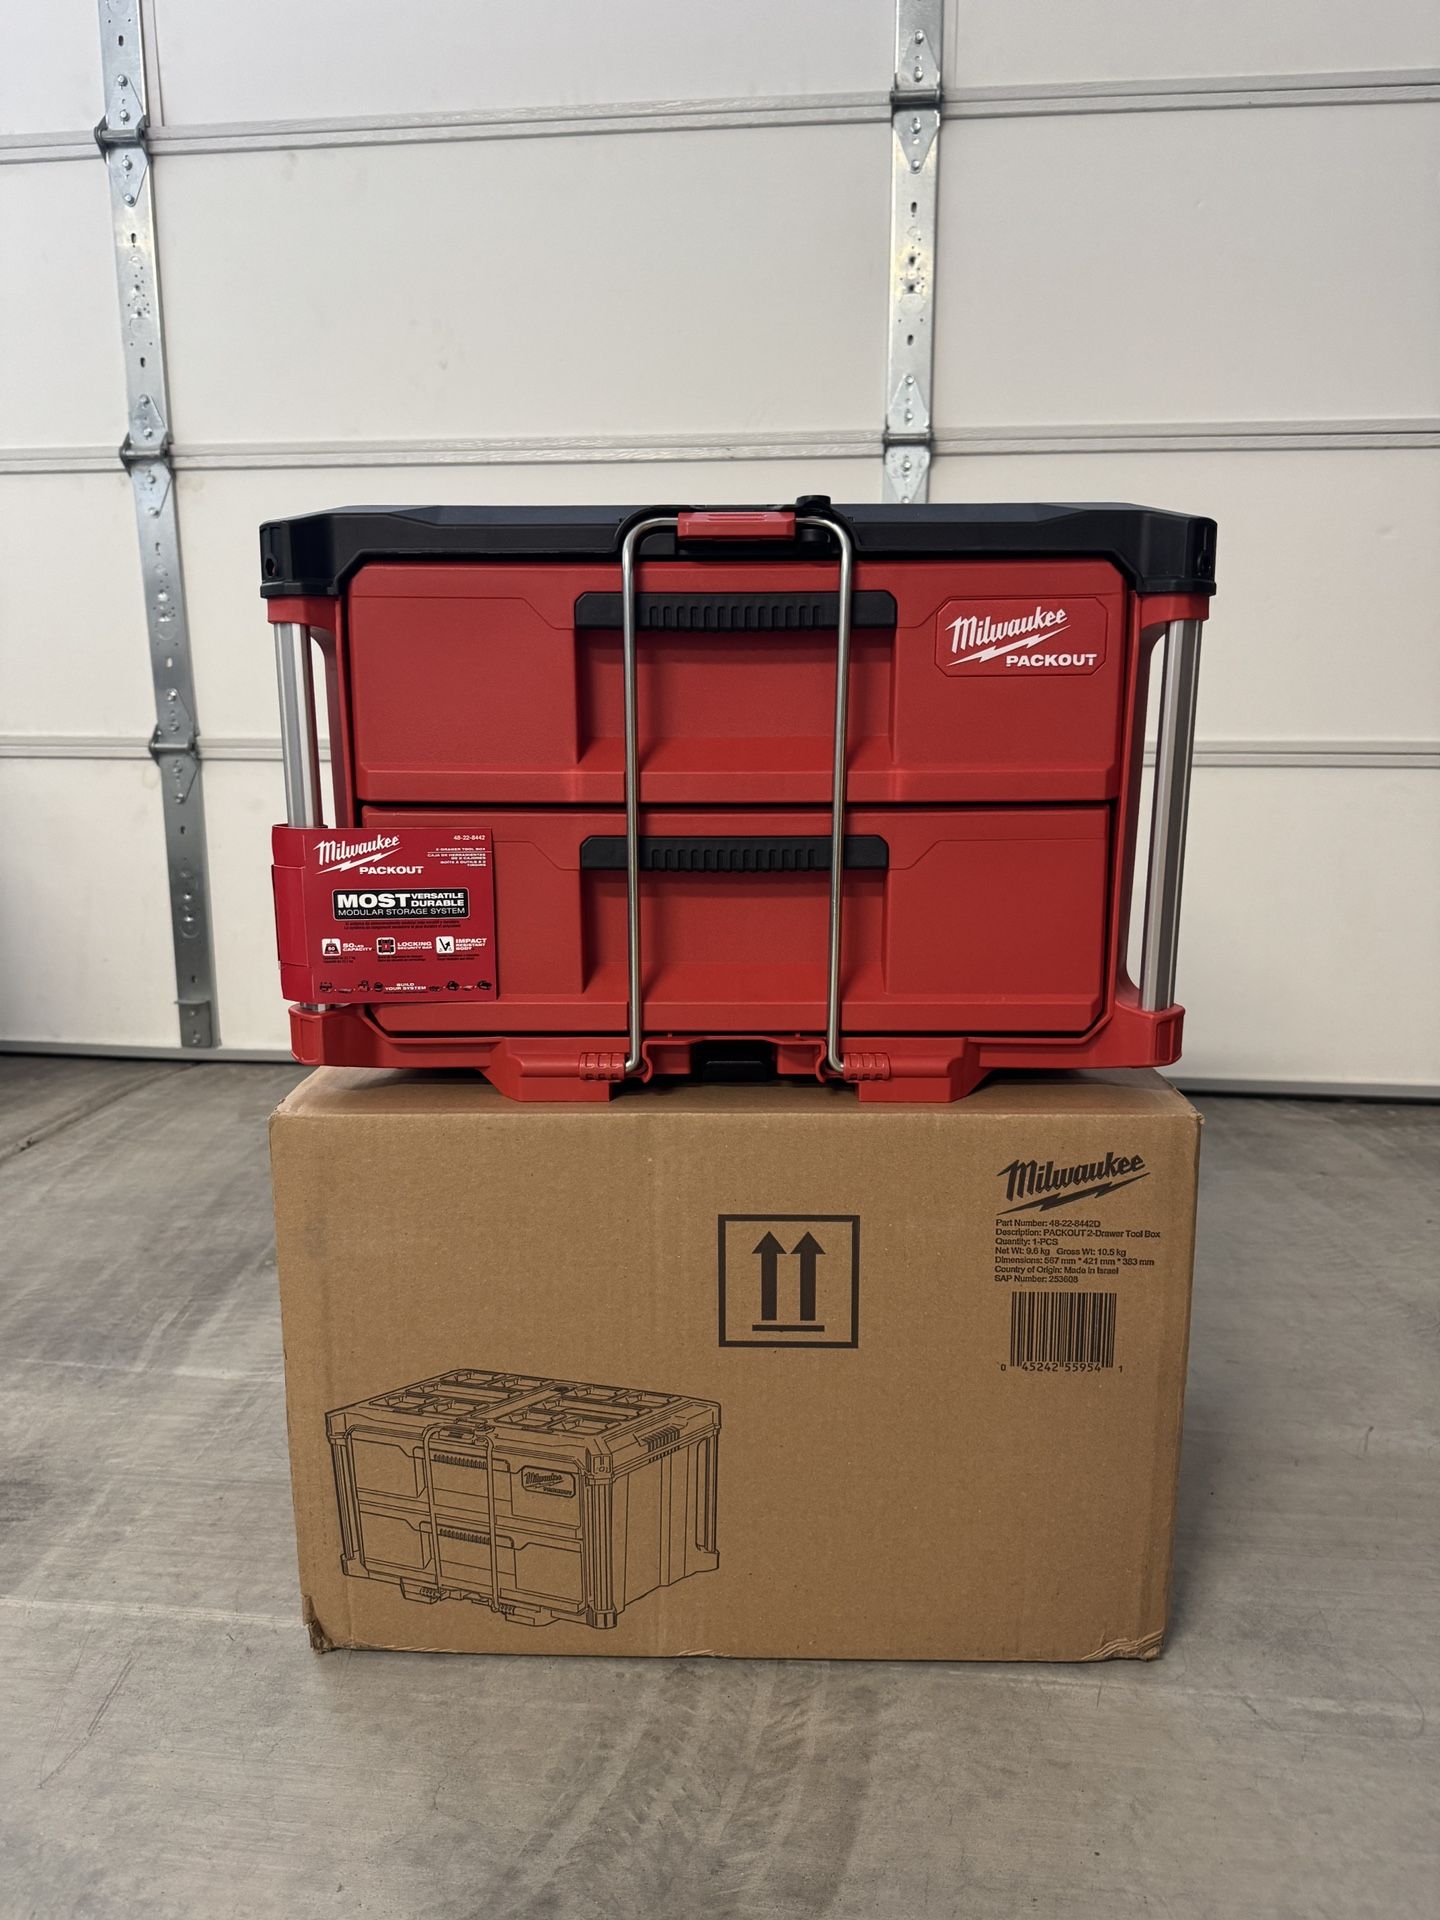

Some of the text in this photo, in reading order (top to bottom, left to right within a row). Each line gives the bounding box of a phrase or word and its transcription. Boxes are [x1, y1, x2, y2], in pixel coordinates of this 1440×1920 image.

[945, 606, 1068, 654] Milwaukee
[1006, 654, 1097, 667] PACKOUT
[313, 834, 400, 865] Milwaukee
[359, 866, 424, 875] PACKOUT
[337, 893, 410, 908] MOST
[997, 1152, 1145, 1201] Milwaukee
[996, 1219, 1101, 1228] Part Number: 48-22-8442D
[995, 1228, 1042, 1237] Description:
[1144, 1230, 1160, 1238] Box
[995, 1238, 1031, 1246] Quantity:
[1040, 1248, 1050, 1256] kg
[1116, 1249, 1126, 1257] kg
[995, 1256, 1042, 1264] Dimensions:
[995, 1266, 1025, 1274] Country
[1036, 1266, 1062, 1275] Origin:
[1014, 1275, 1047, 1283] Number:
[1000, 1362, 1123, 1373] 0 45242 55954 1
